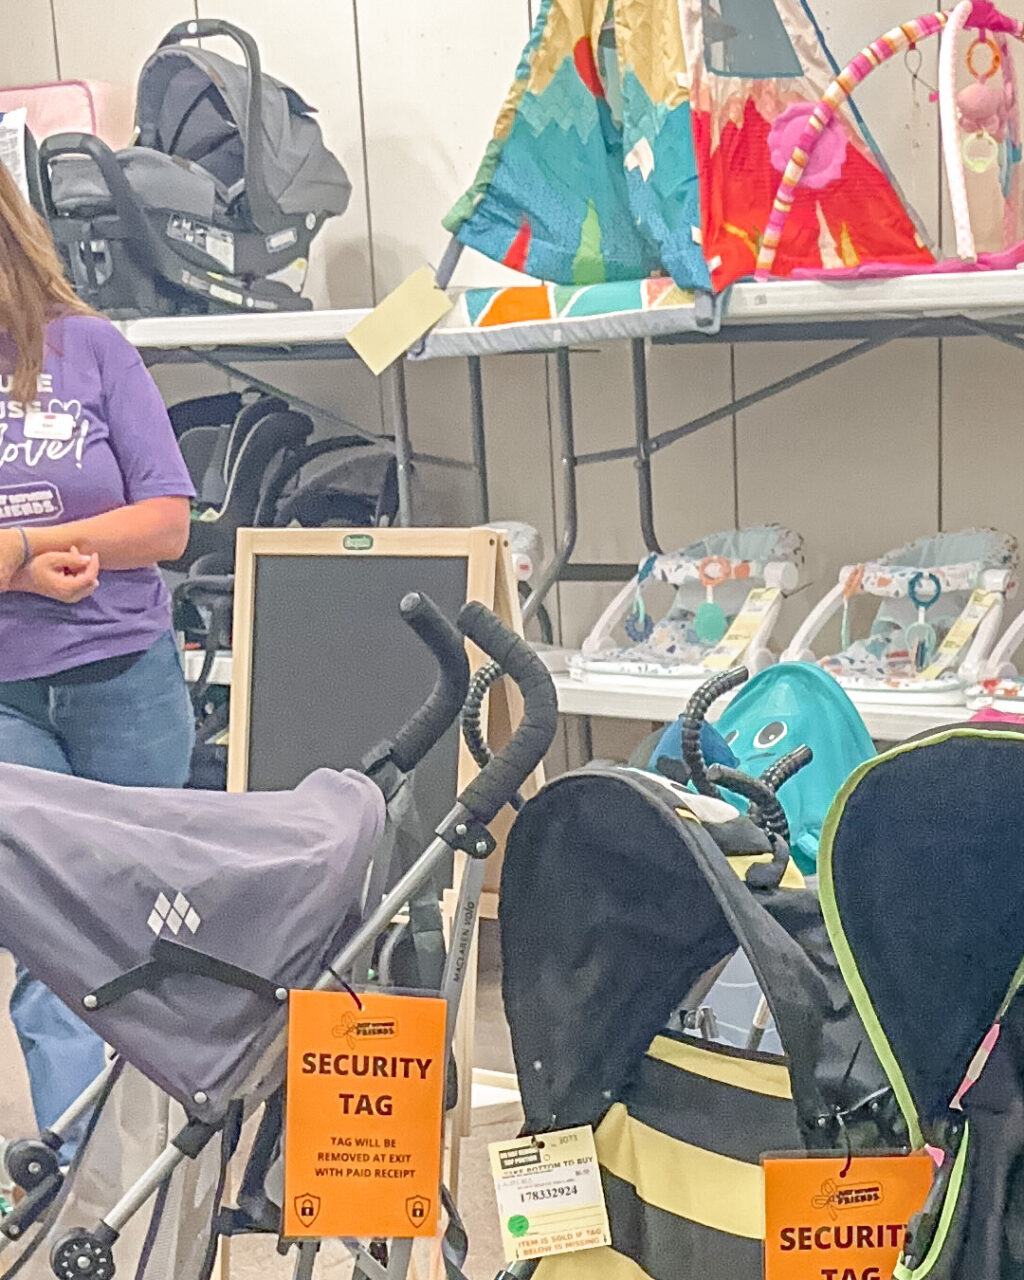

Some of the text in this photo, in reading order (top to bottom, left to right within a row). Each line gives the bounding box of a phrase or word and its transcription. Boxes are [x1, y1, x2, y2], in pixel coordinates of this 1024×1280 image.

[0, 374, 53, 393] UE
[453, 929, 469, 983] MACLAREN
[301, 1052, 433, 1080] SECURITY
[338, 1093, 394, 1116] TAG
[330, 1136, 397, 1148] TAG WILL BE
[317, 1151, 412, 1164] REMOVED AT EXIT
[577, 1157, 593, 1165] BUY
[315, 1167, 416, 1179] WITH PAID RECEIPT
[520, 1185, 578, 1203] 178332924
[518, 1239, 538, 1248] ITEM
[780, 1225, 907, 1251] SECURIT
